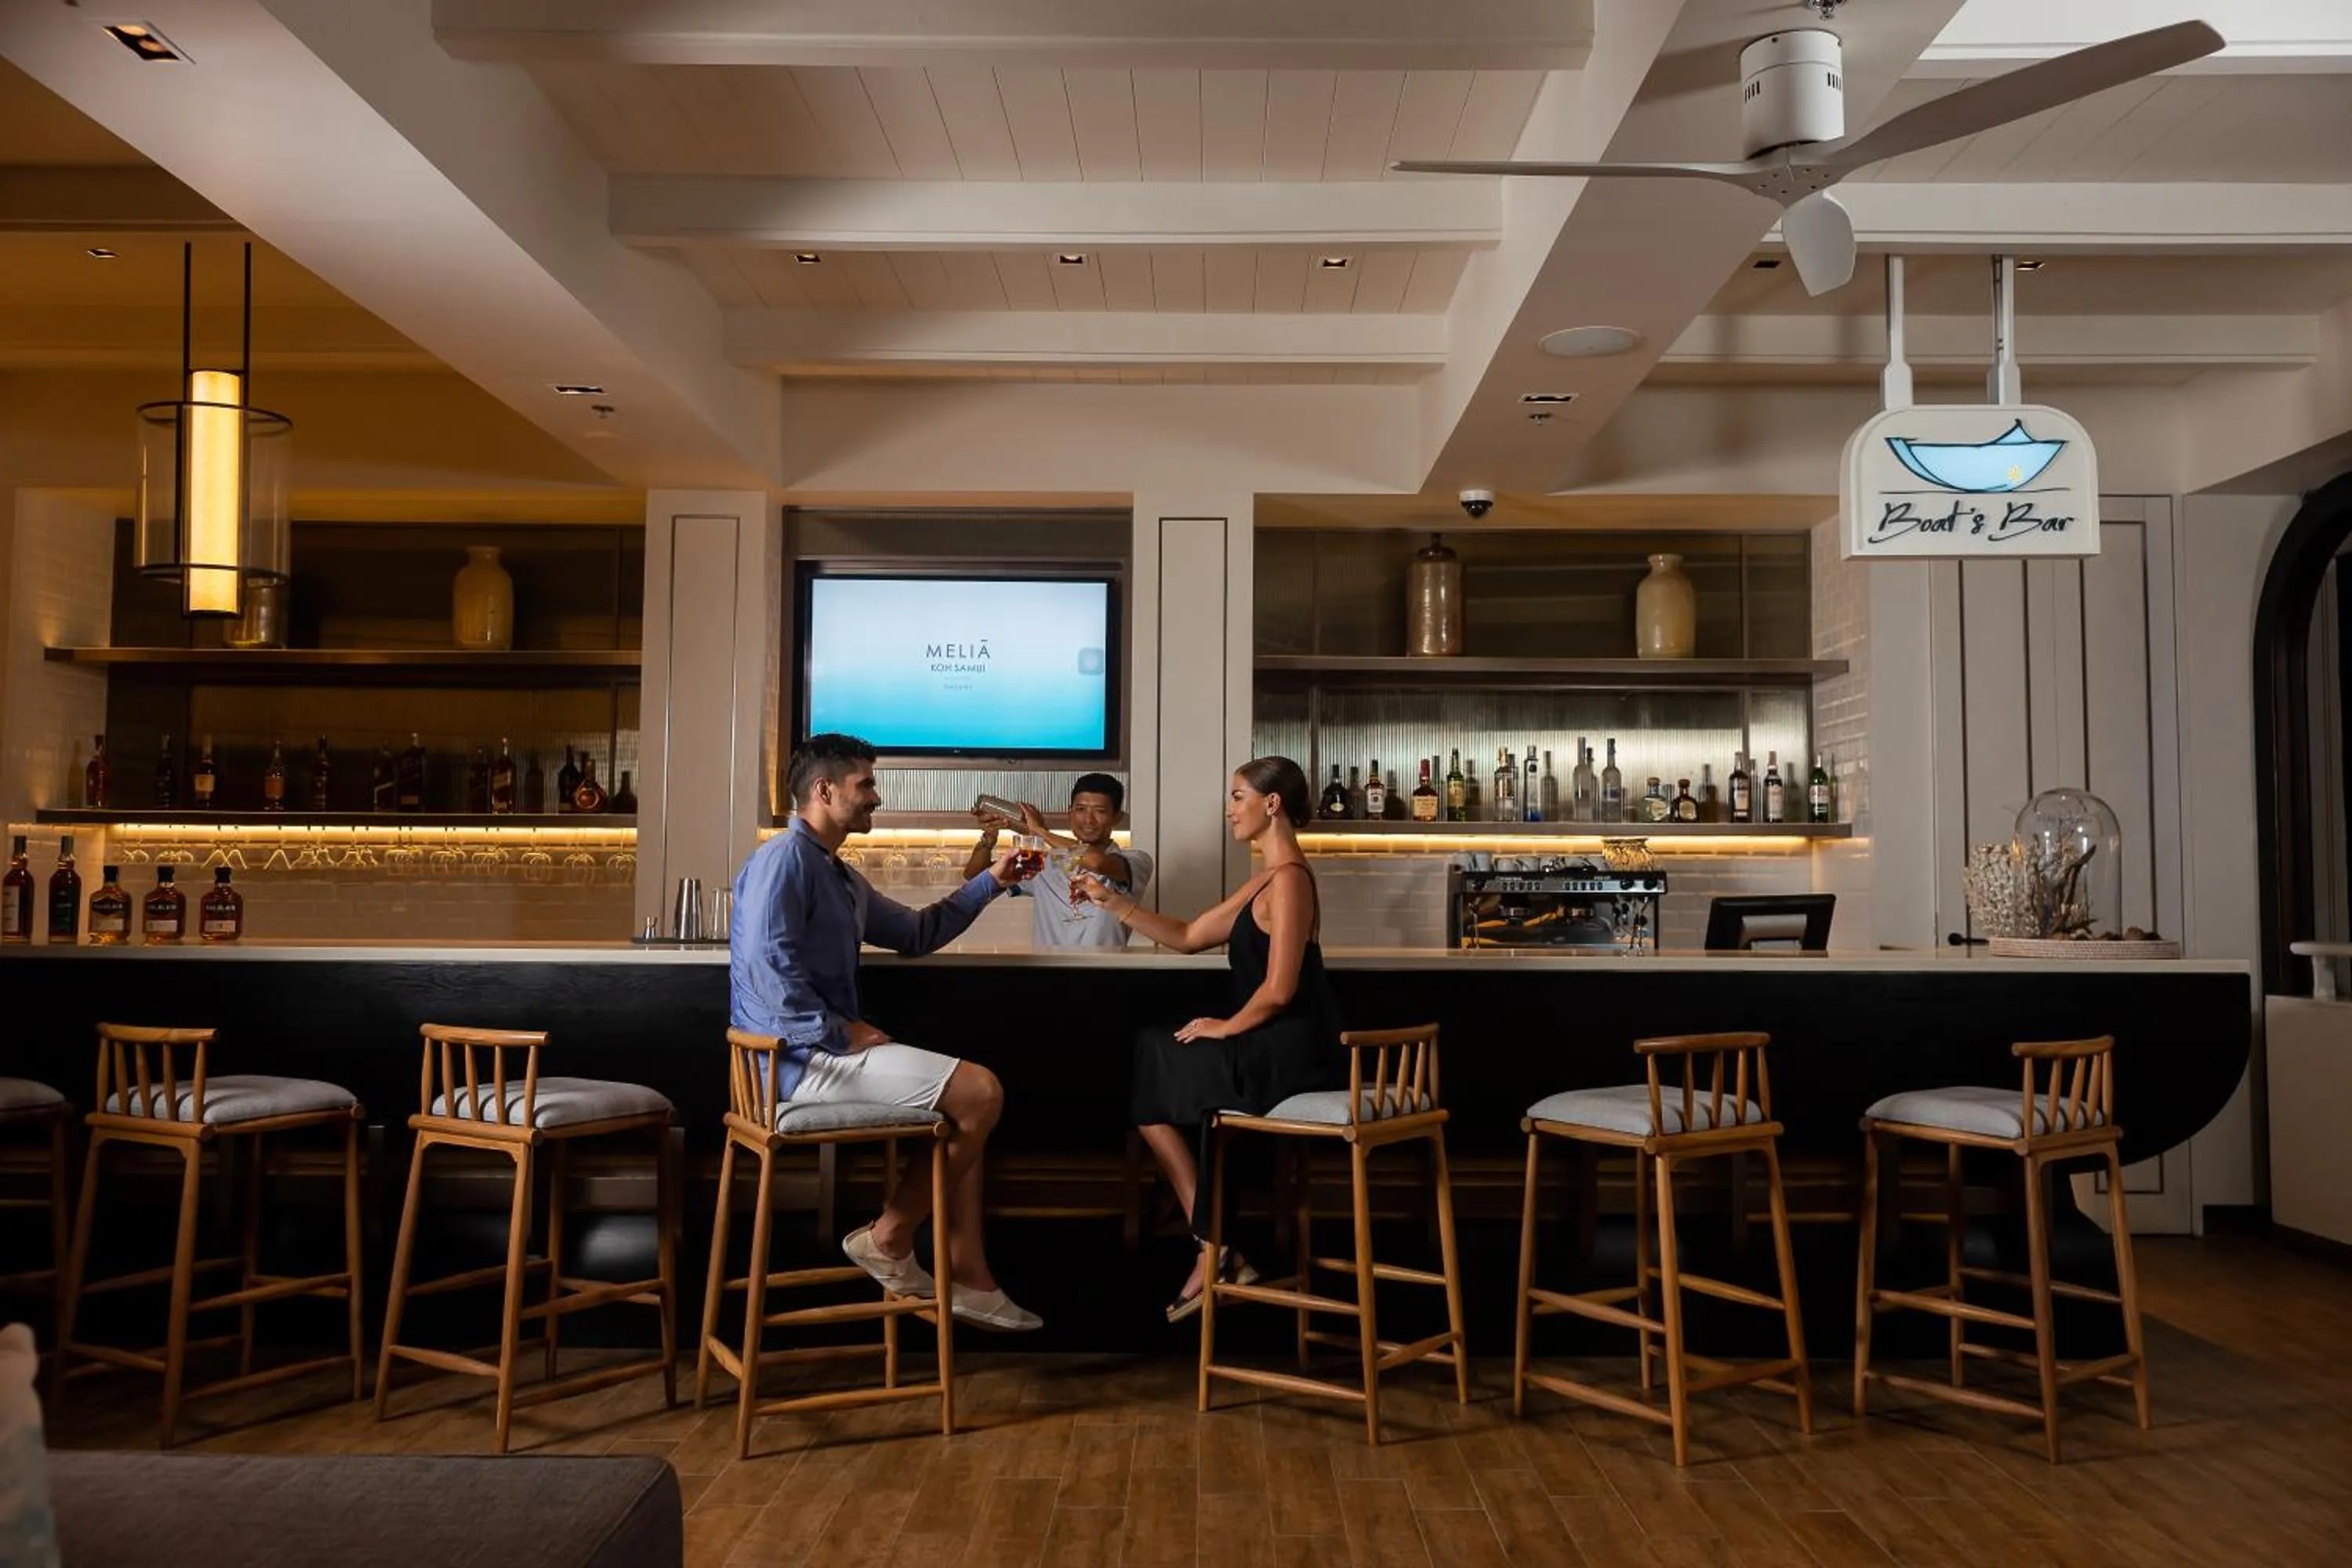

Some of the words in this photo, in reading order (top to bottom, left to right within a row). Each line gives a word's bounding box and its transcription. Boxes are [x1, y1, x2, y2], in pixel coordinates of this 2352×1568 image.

[1867, 499, 1985, 543] Boat's
[1987, 501, 2076, 542] Bar
[931, 663, 952, 672] KOH
